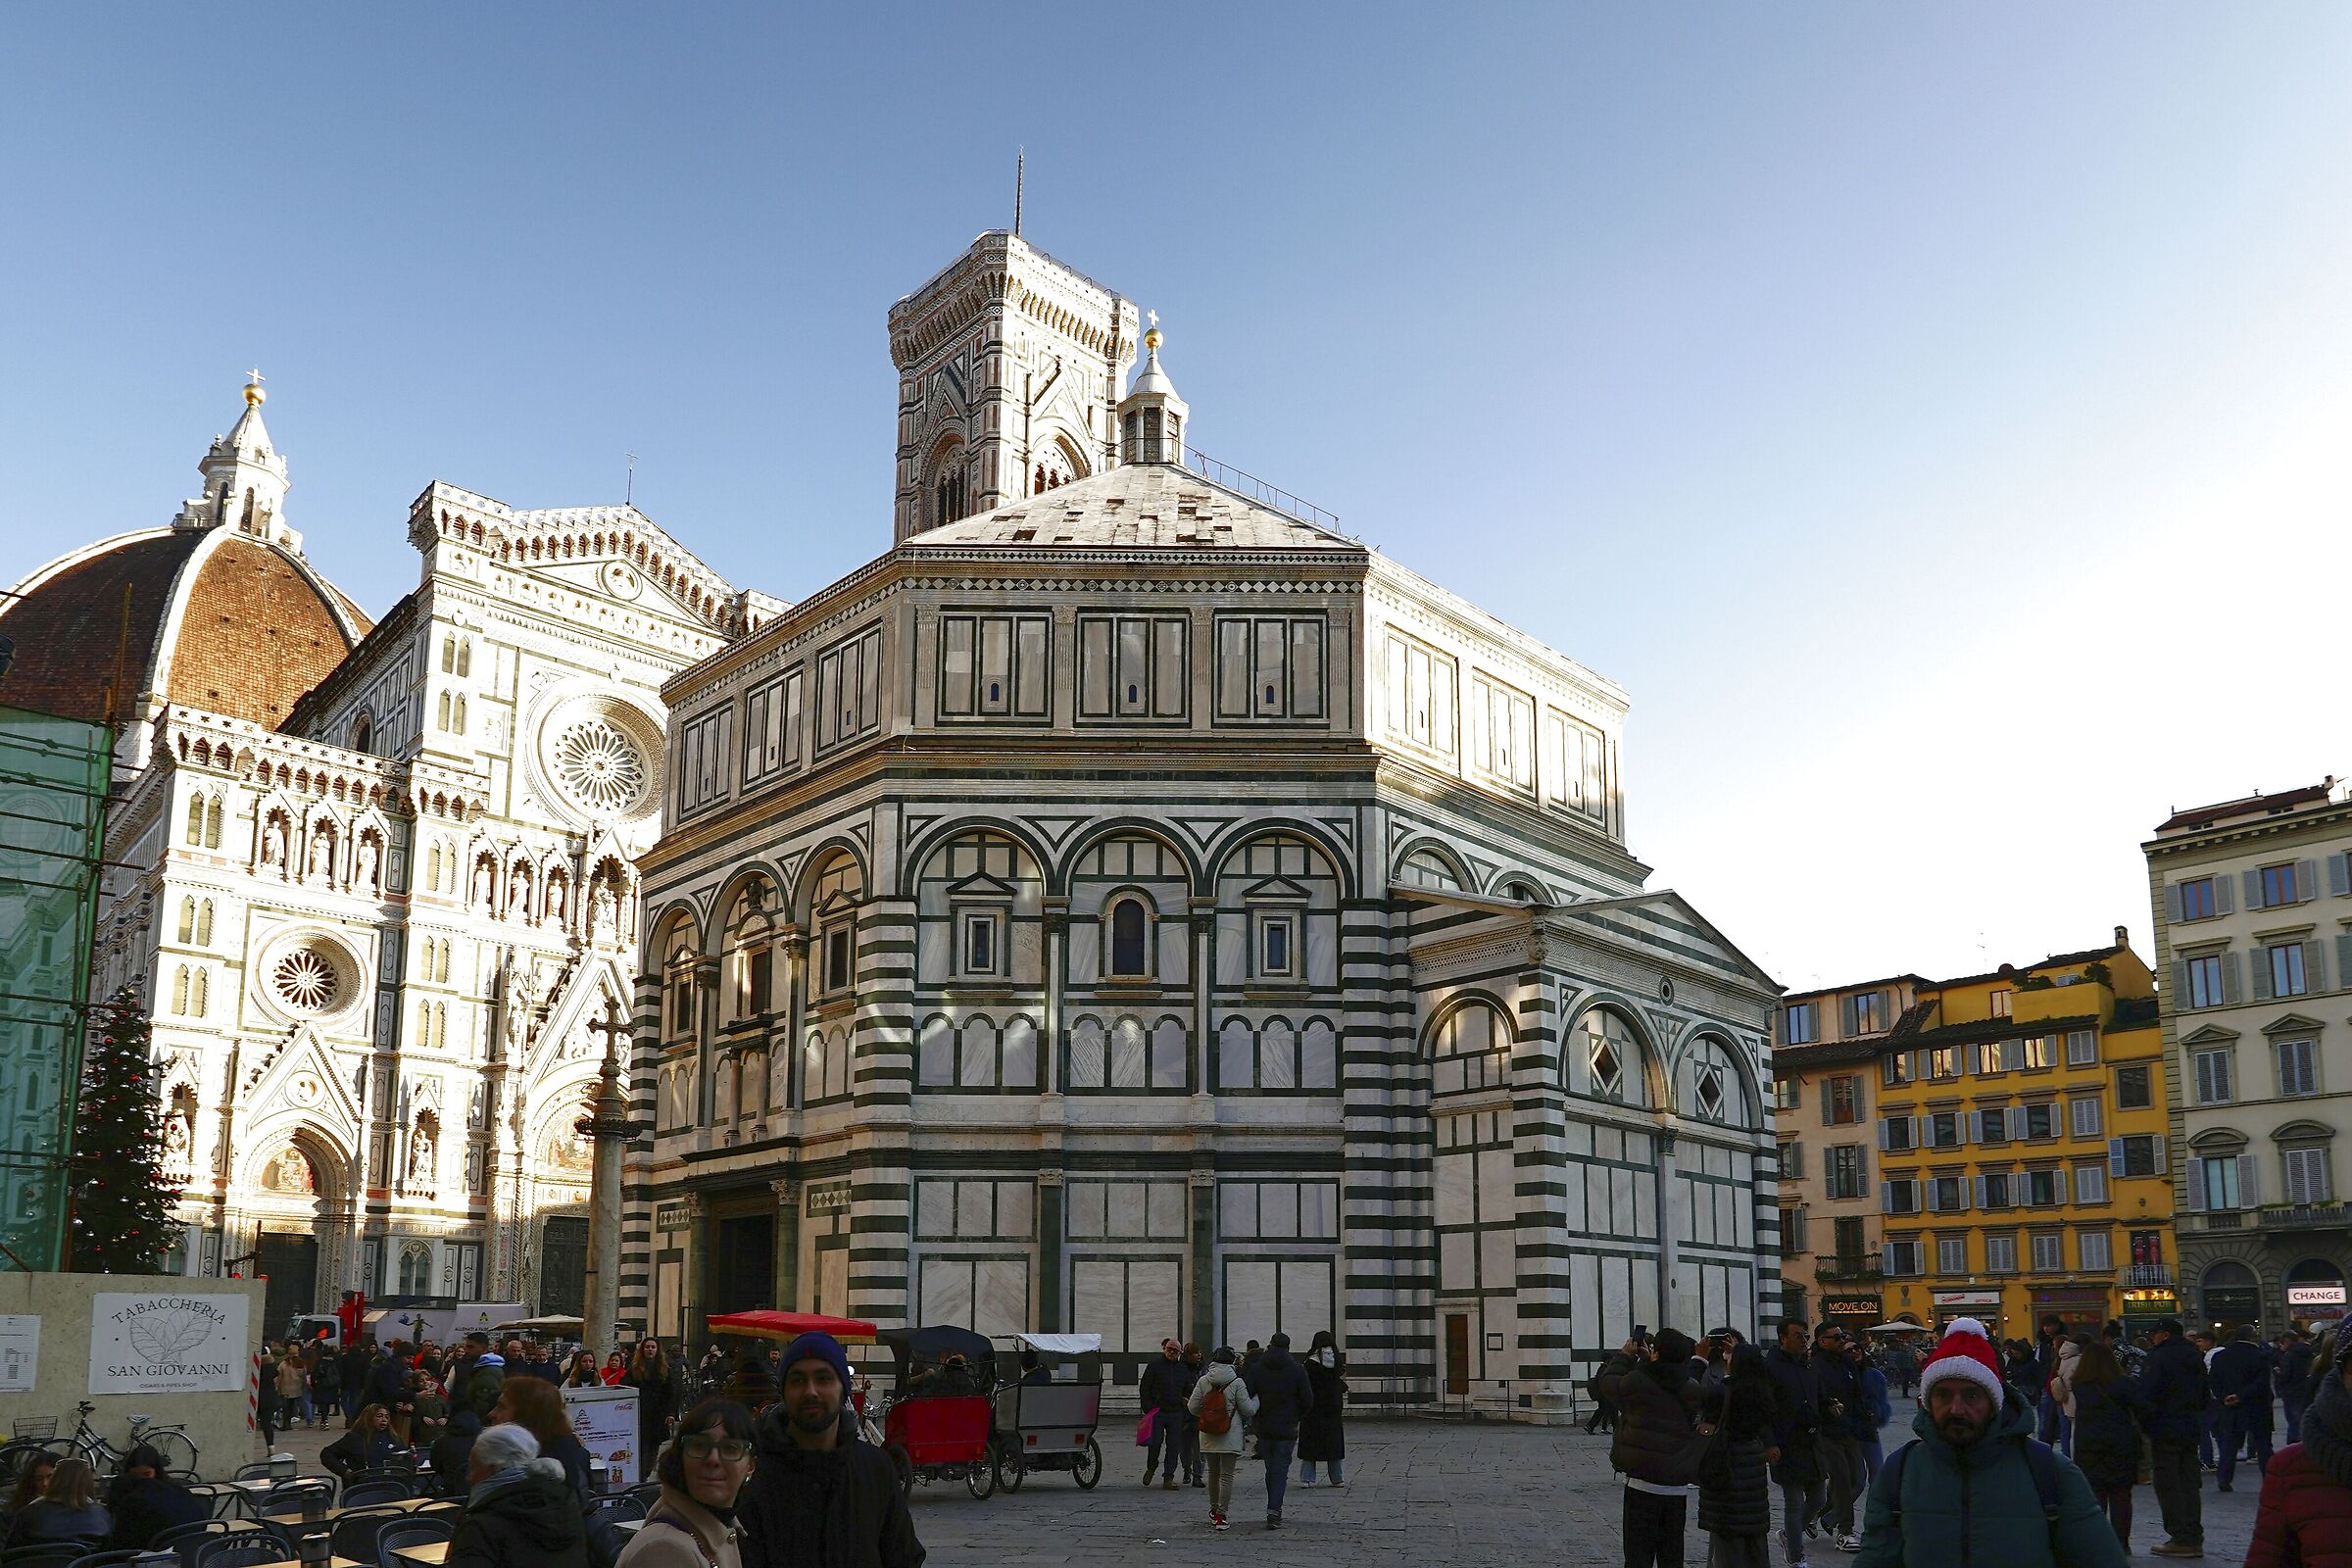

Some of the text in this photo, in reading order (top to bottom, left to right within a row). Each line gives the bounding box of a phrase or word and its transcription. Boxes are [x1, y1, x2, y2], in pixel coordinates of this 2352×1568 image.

[2293, 1291, 2341, 1300] CHANGE
[1828, 1300, 1879, 1311] MOVE ON
[2126, 1301, 2151, 1310] IRISH
[111, 1298, 226, 1325] TABACCHERIA
[108, 1363, 229, 1377] SAN GIOVANNI
